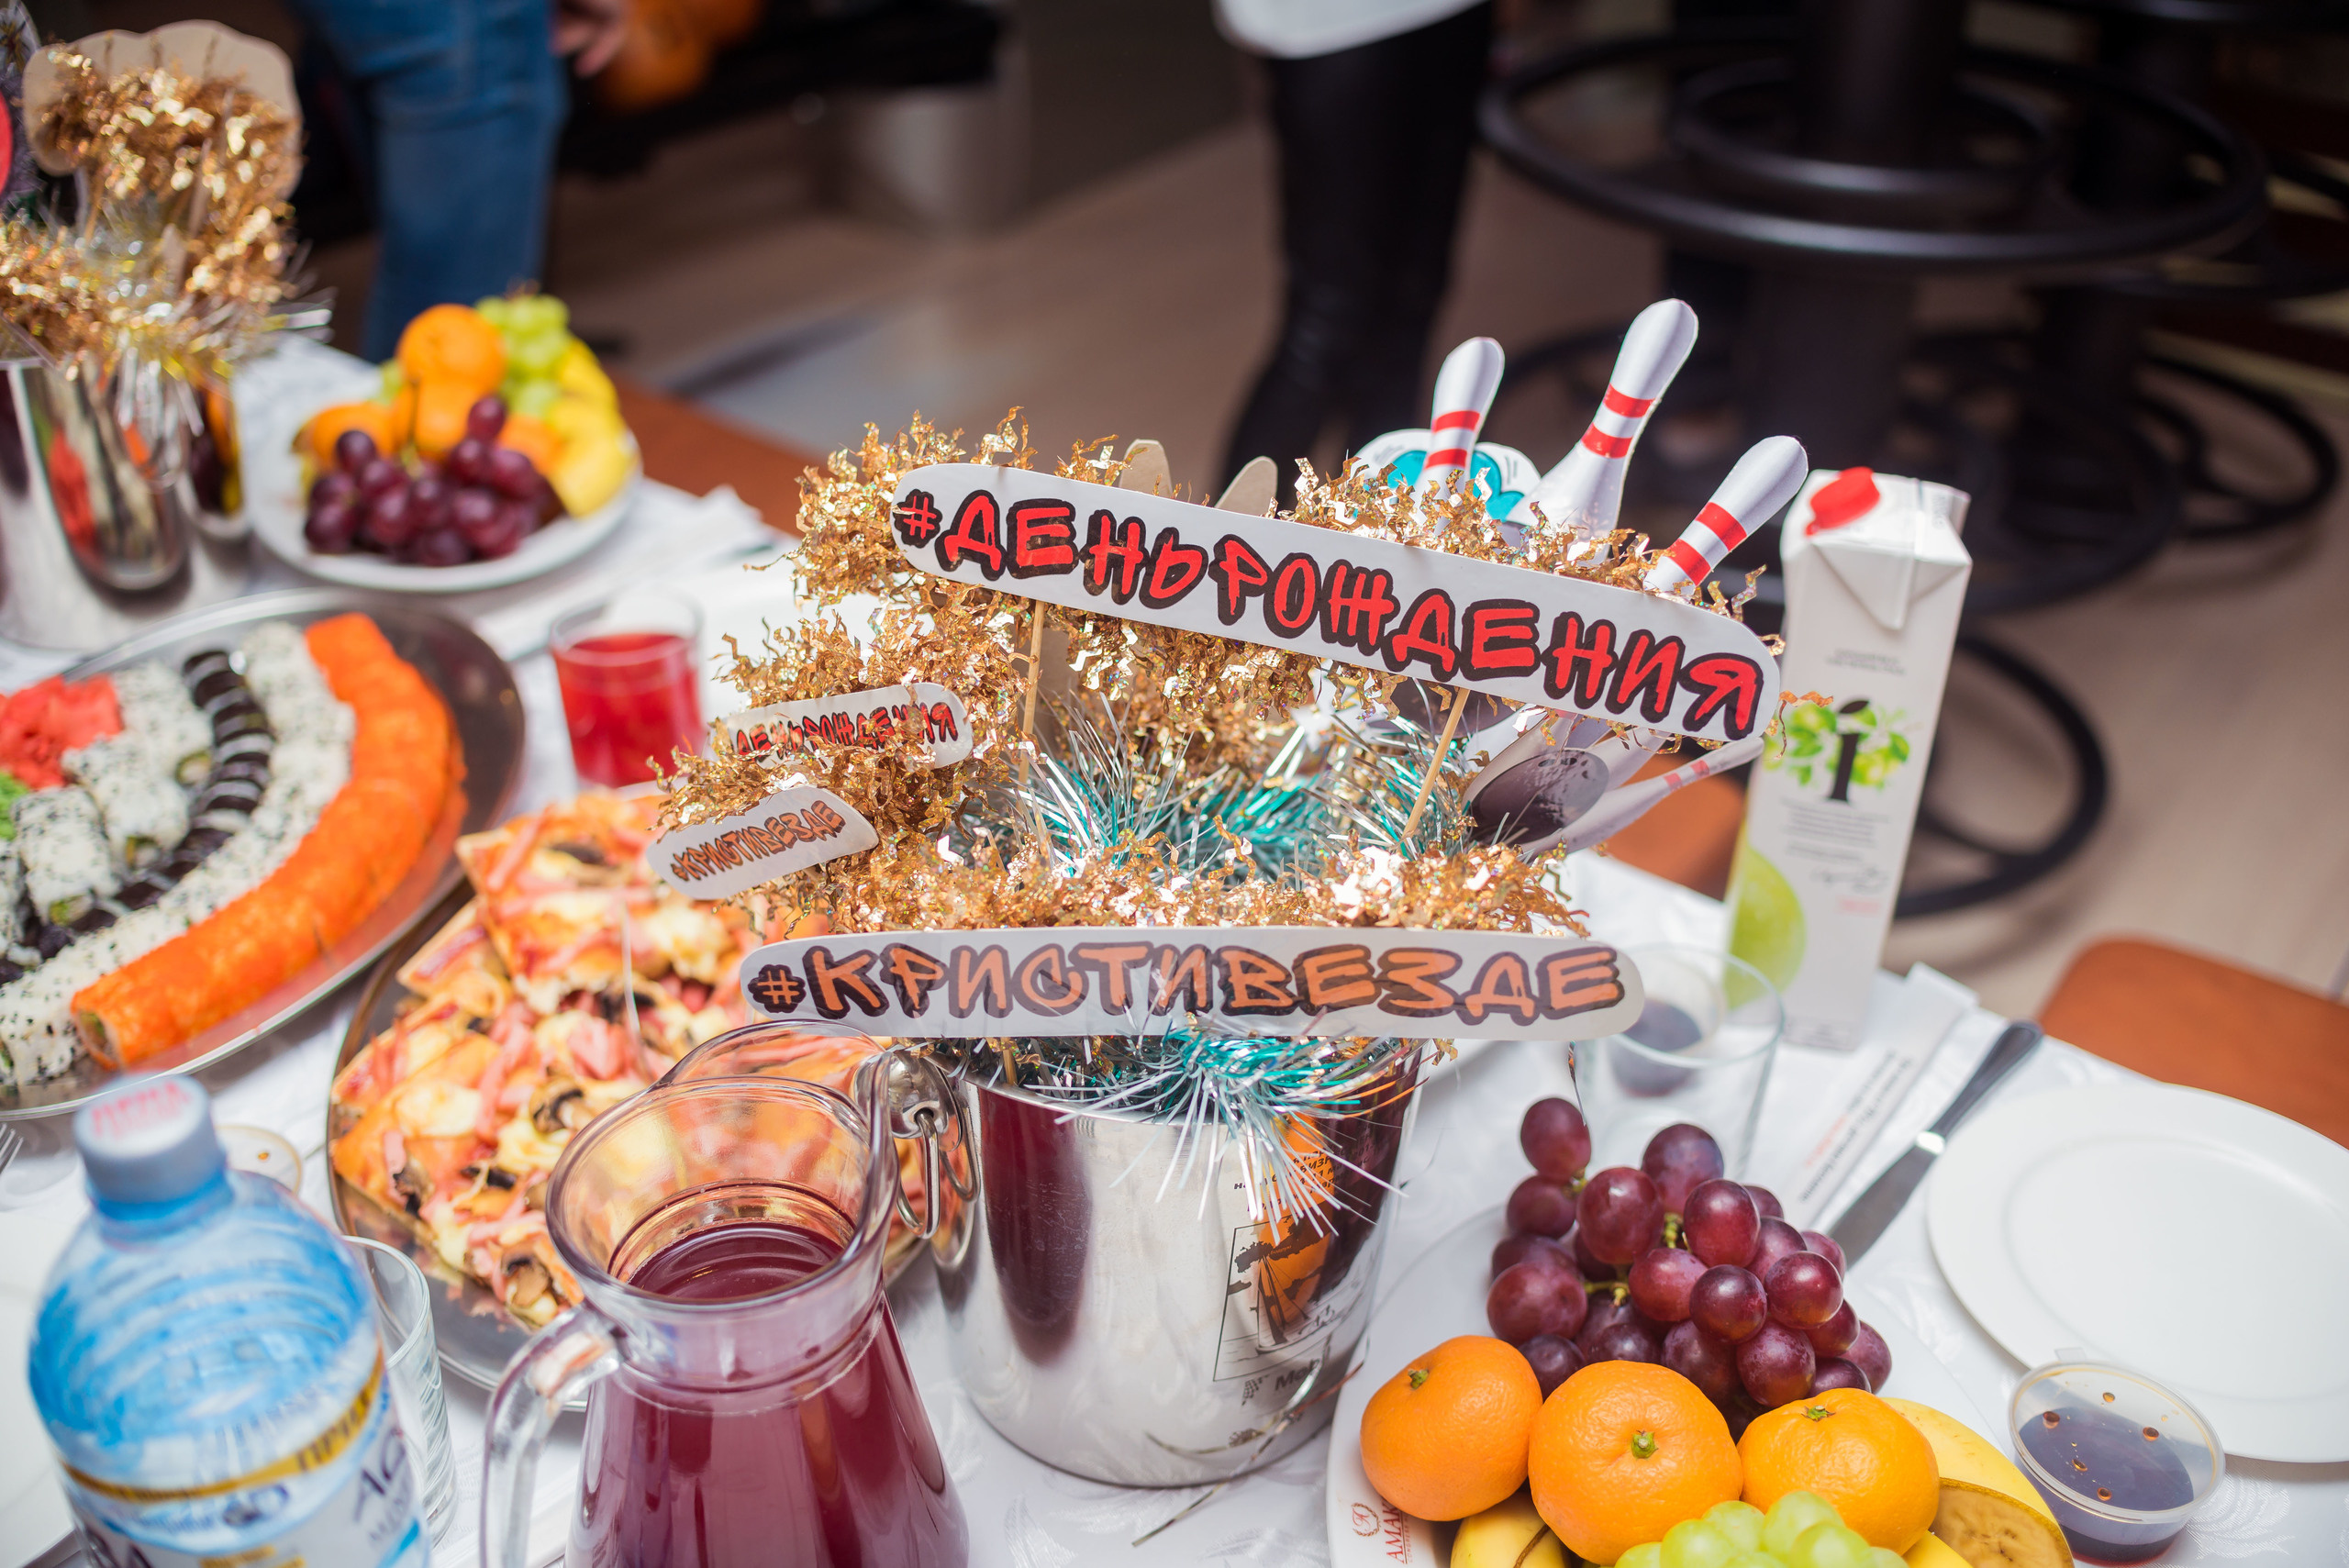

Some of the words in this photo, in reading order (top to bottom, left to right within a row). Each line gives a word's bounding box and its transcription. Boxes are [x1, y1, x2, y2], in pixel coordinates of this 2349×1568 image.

[892, 487, 1765, 740] #ДЕНЬРОЖДЕНИЯ
[670, 799, 847, 882] #КРИСТИВЕЗДЕ
[747, 941, 1625, 1020] #КРИСТИВЕЗДЕ
